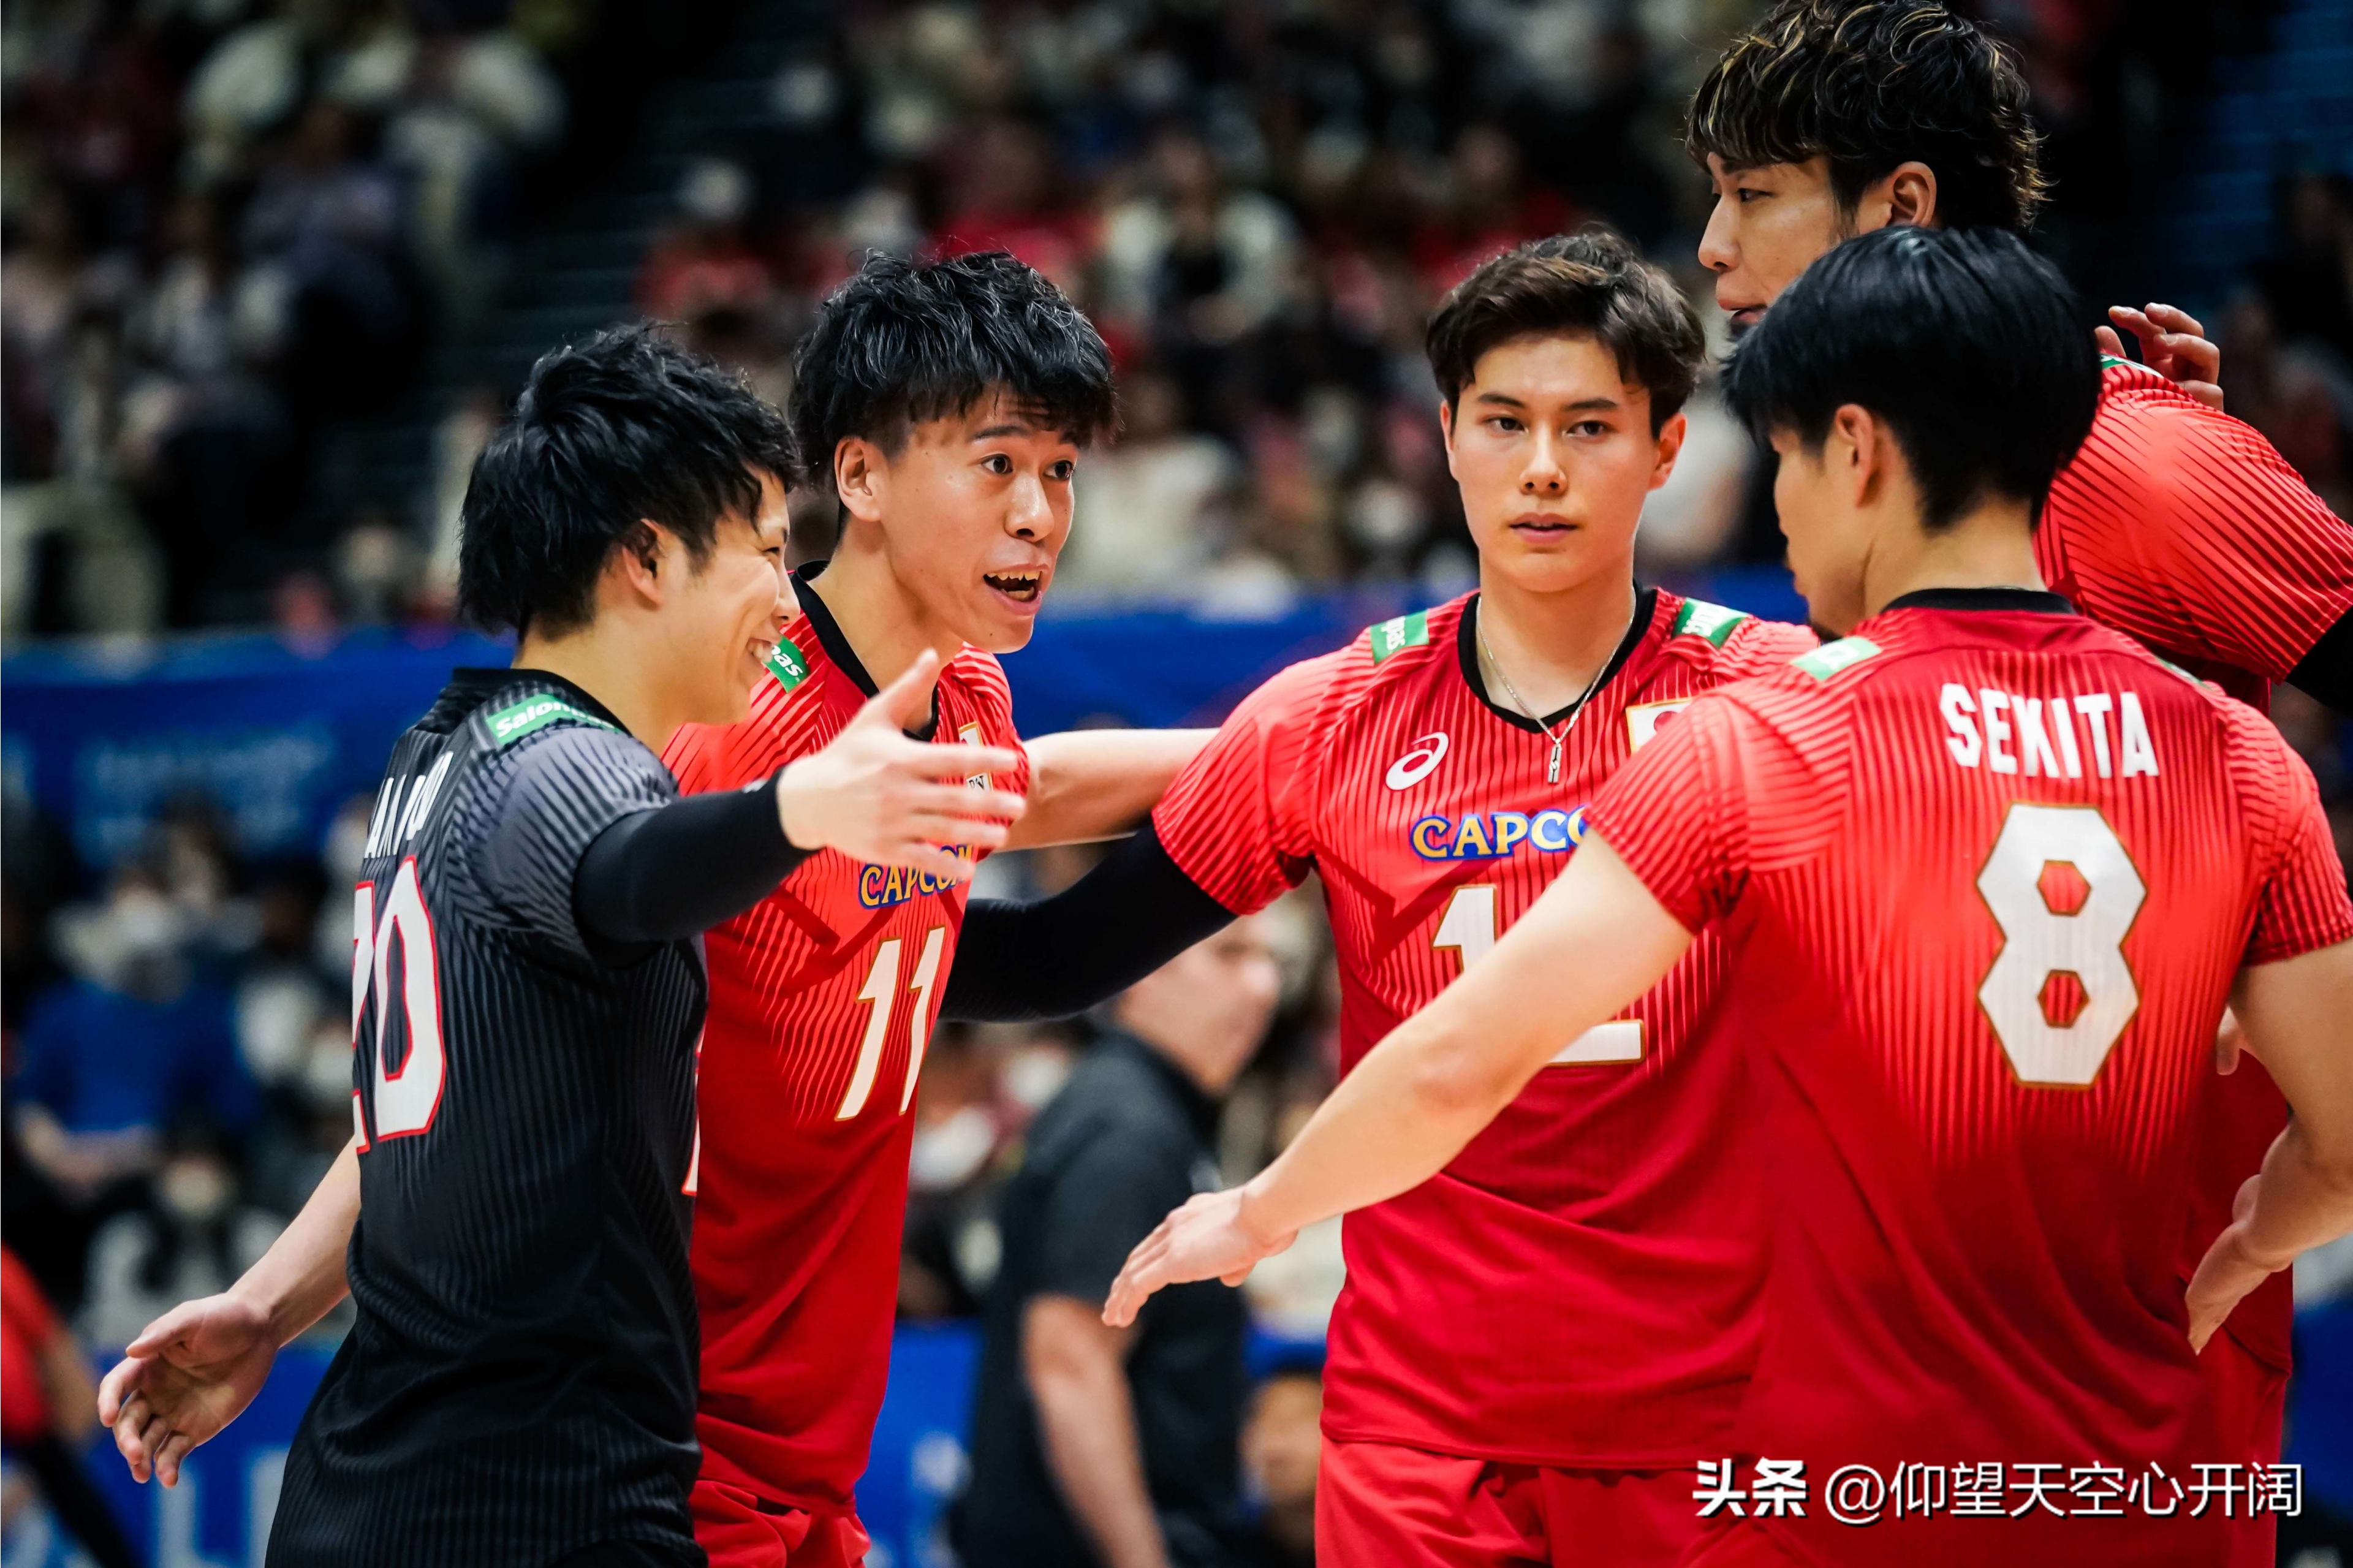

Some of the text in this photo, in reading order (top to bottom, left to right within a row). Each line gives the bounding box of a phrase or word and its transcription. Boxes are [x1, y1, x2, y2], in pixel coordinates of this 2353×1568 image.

[1939, 683, 2159, 779] SEKITA
[834, 925, 945, 1121] 11
[1976, 801, 2147, 1090] 8
